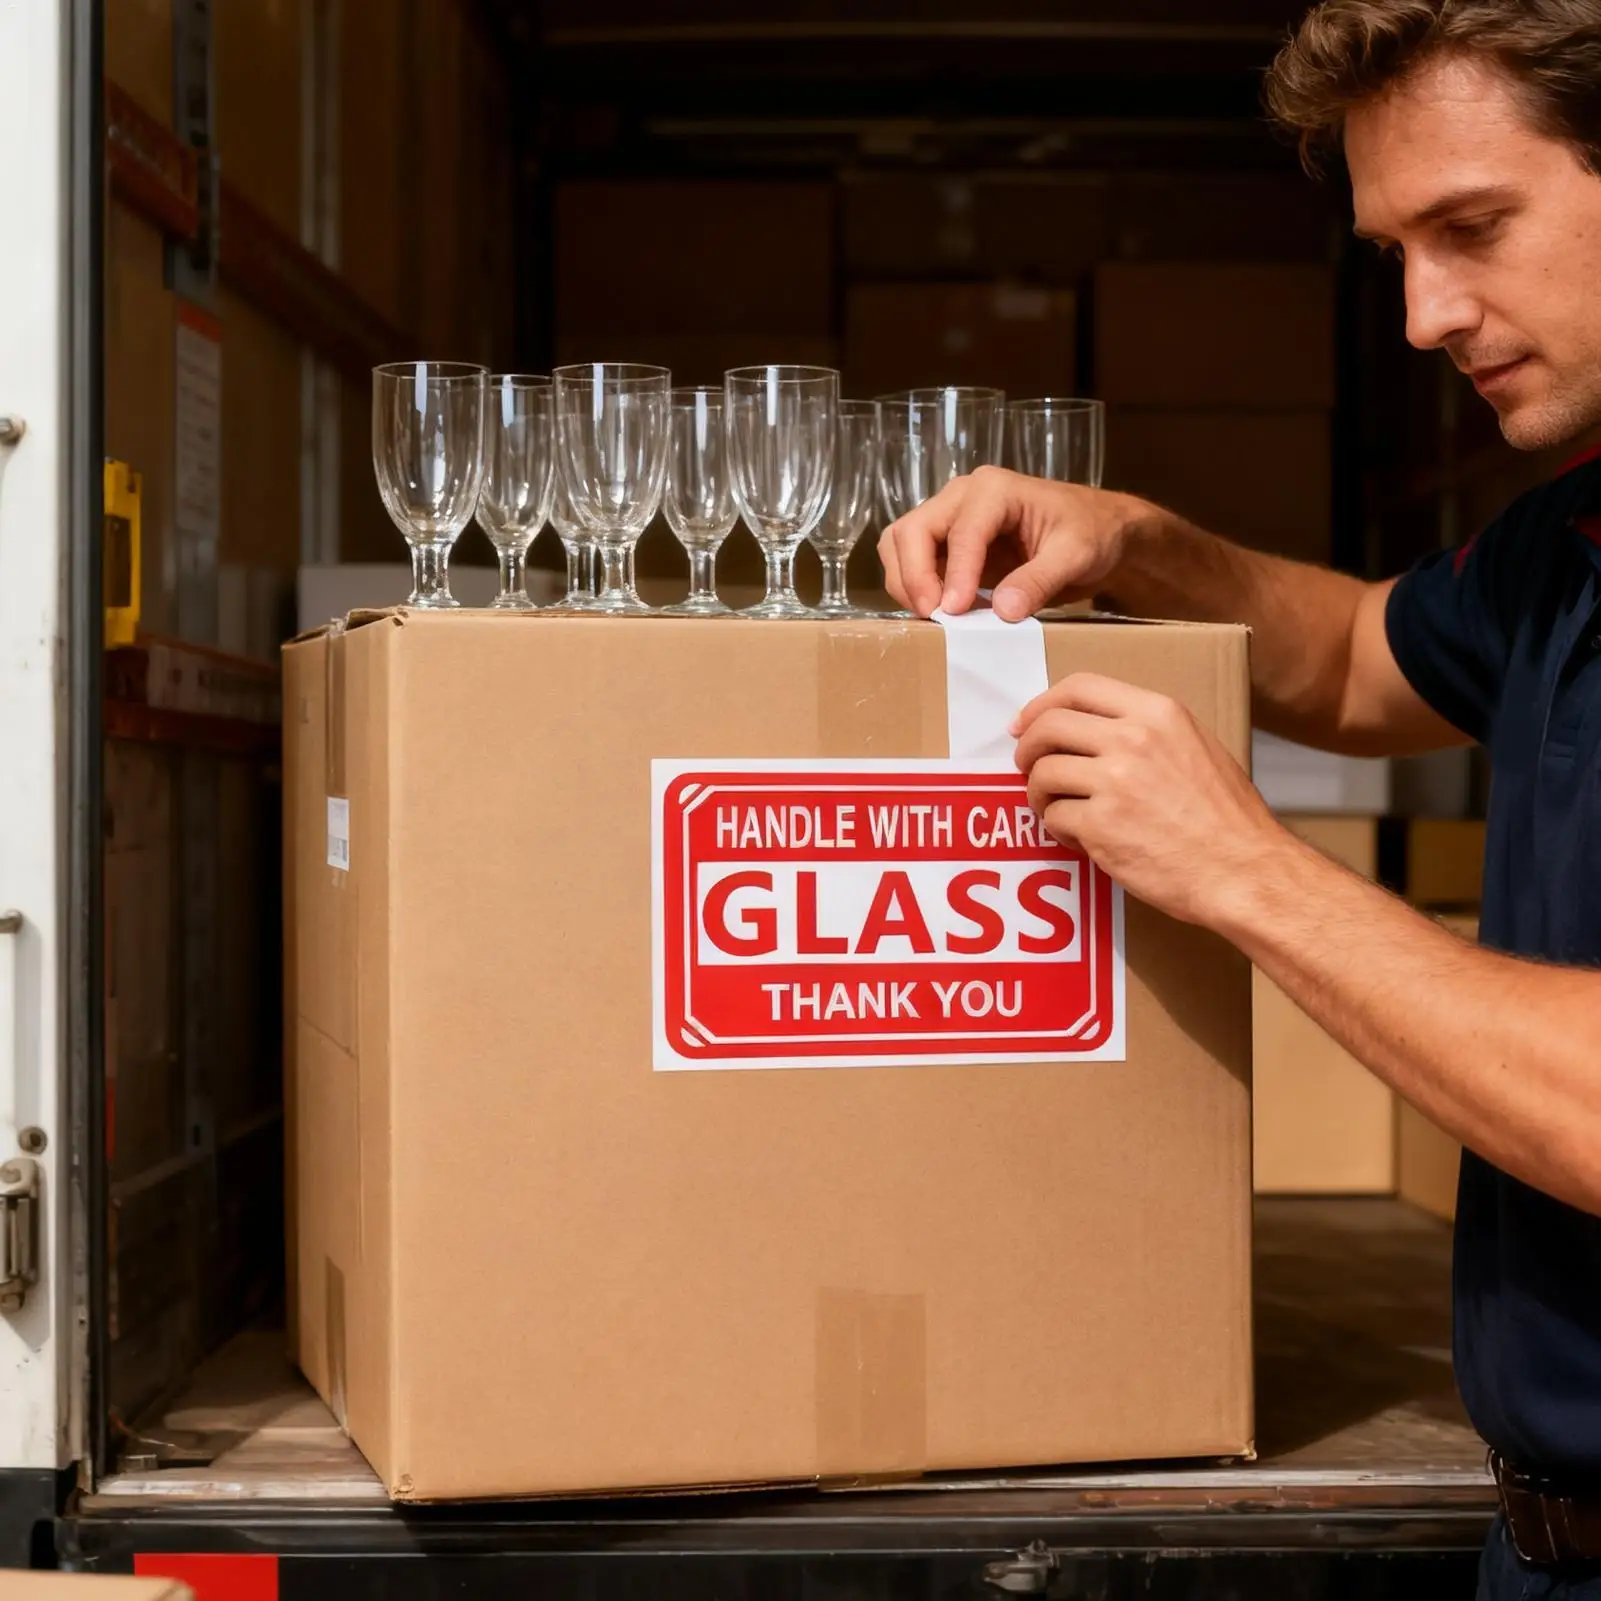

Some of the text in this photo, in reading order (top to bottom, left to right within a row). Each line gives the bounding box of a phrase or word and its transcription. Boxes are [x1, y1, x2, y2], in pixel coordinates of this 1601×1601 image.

[717, 804, 856, 848] HANDLE
[868, 804, 953, 848] WITH
[702, 870, 1076, 957] GLASS
[761, 980, 1023, 1021] THANK YOU
